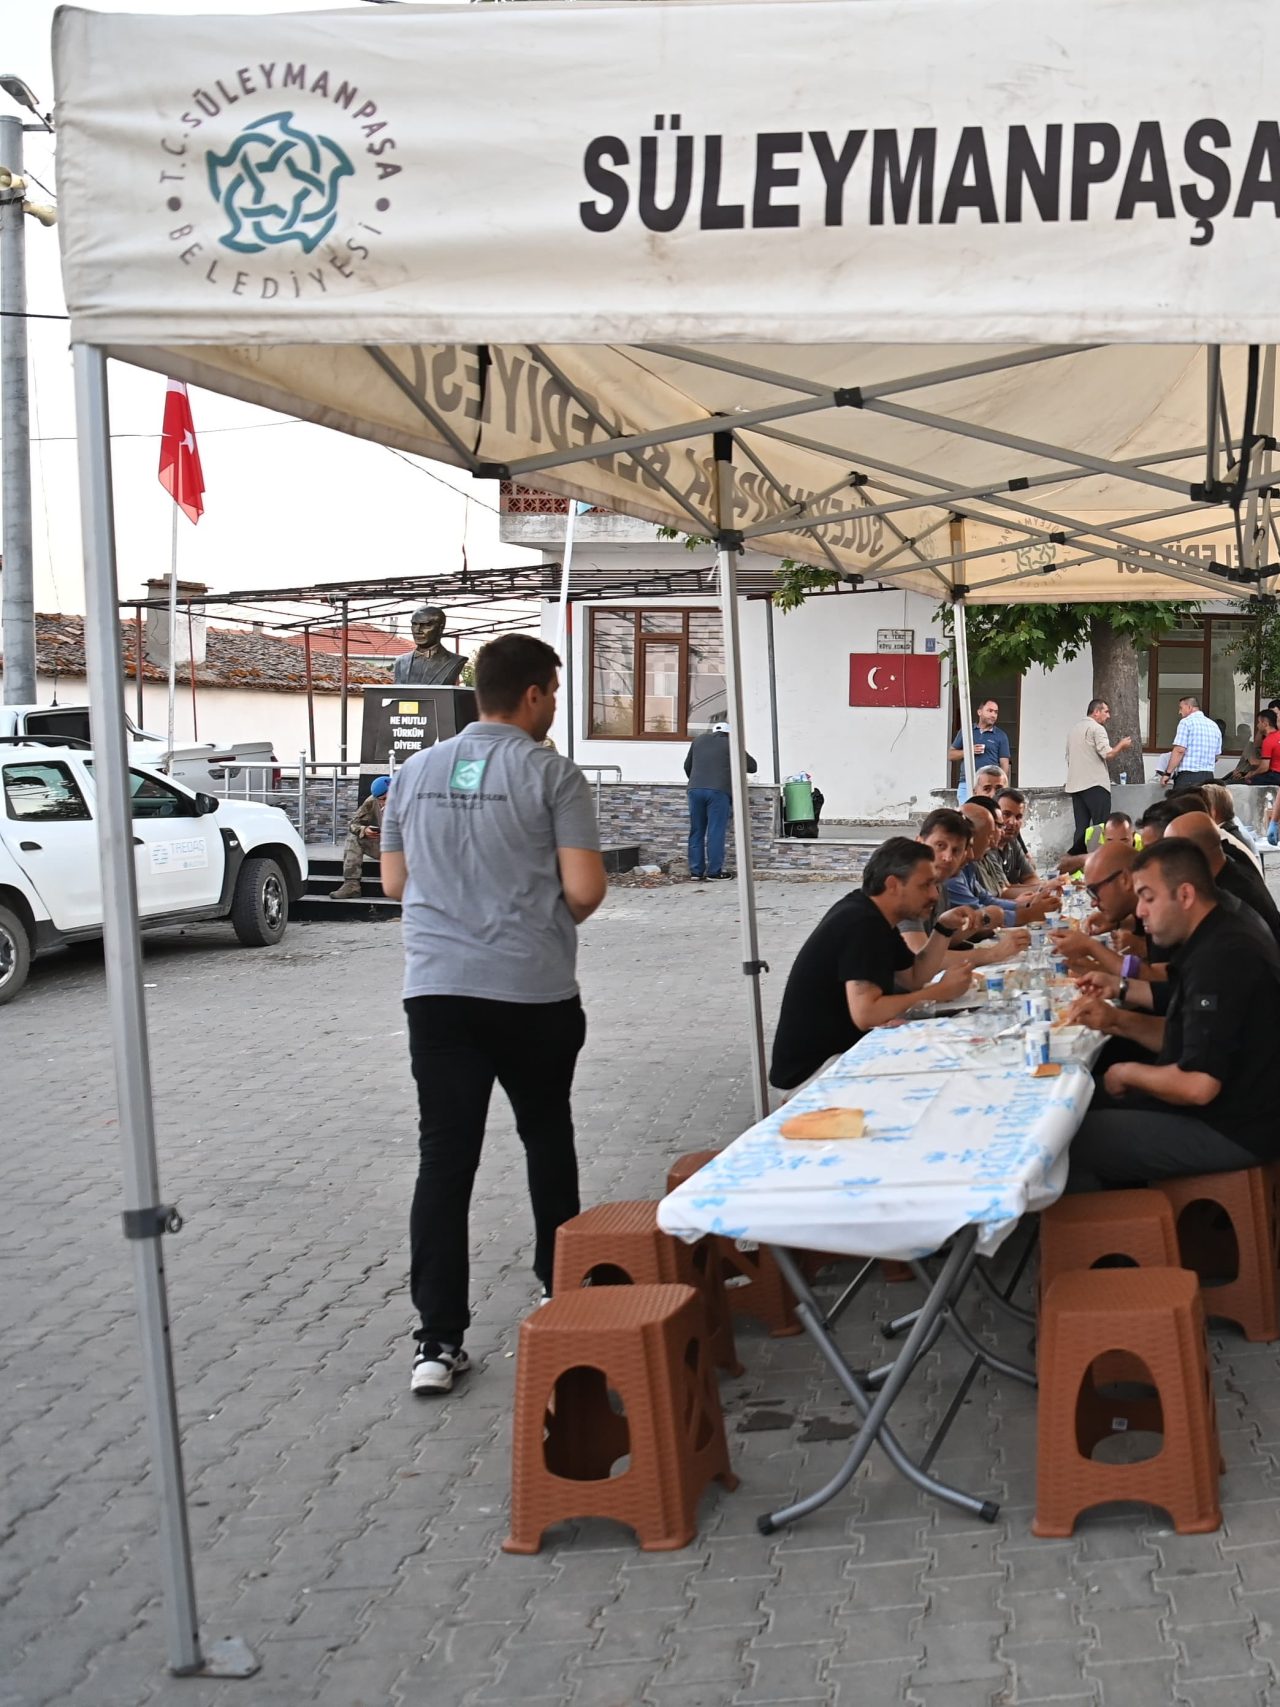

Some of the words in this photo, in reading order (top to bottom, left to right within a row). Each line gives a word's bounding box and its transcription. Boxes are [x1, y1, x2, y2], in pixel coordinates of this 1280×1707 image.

[160, 133, 189, 183] T.C.
[181, 63, 402, 180] SÜLEYMANPAŞA
[169, 222, 382, 299] BELEDİYESİ
[390, 716, 400, 725] NE
[401, 716, 427, 725] MUTLU
[392, 727, 424, 738] TÜRKÜM
[394, 740, 422, 750] DİYENE
